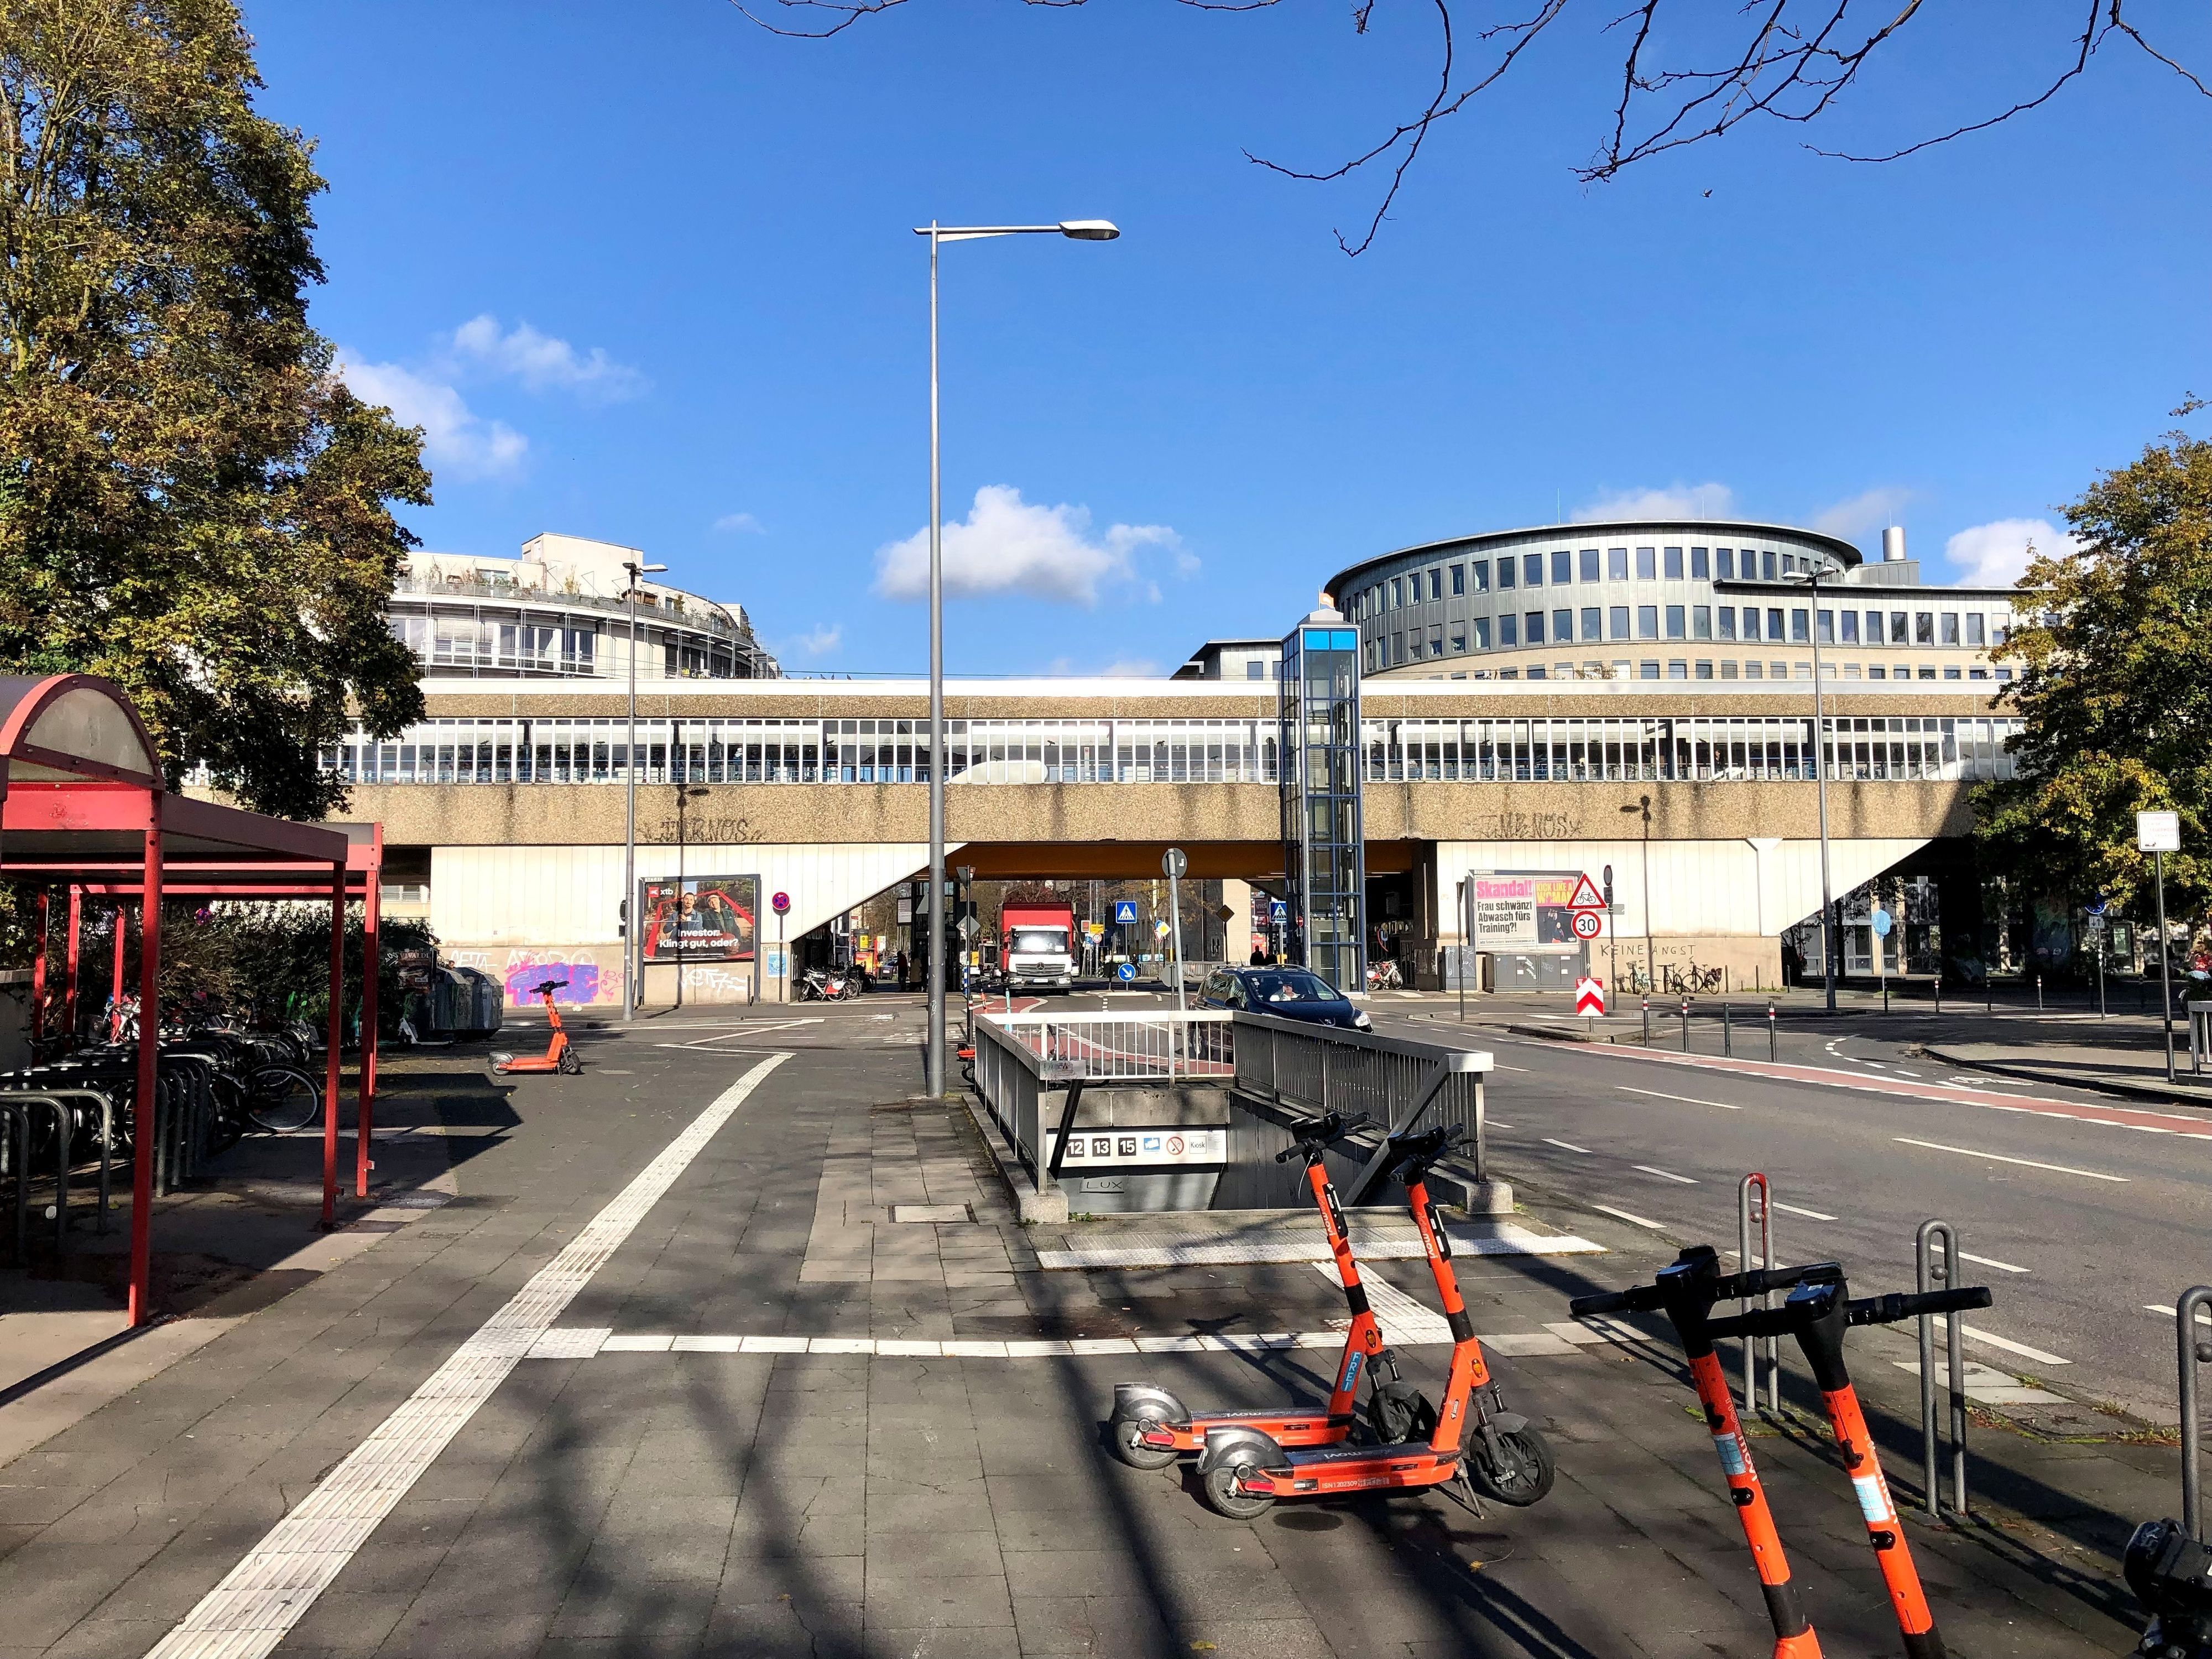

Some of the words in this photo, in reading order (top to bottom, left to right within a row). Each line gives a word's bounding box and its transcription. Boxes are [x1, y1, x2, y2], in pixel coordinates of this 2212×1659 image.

[1477, 880, 1532, 897] Skandal!
[1536, 883, 1552, 891] KICK
[1553, 883, 1566, 891] LIKE
[1478, 901, 1494, 911] Frau
[1496, 900, 1532, 911] schwänzt
[1478, 912, 1514, 922] Abwasch
[1515, 911, 1530, 921] fürs
[1478, 922, 1517, 934] Training?!
[1578, 919, 1595, 931] 30
[659, 940, 688, 950] Klingt
[690, 939, 708, 949] gut,
[710, 938, 739, 947] oder?
[1600, 945, 1644, 957] KEINE
[1652, 945, 1696, 956] ANGST
[1068, 1142, 1083, 1155] 12
[1094, 1141, 1109, 1154] 13
[1120, 1140, 1135, 1153] 15
[1086, 1181, 1123, 1190] LUX
[1344, 1352, 1360, 1391] FREI
